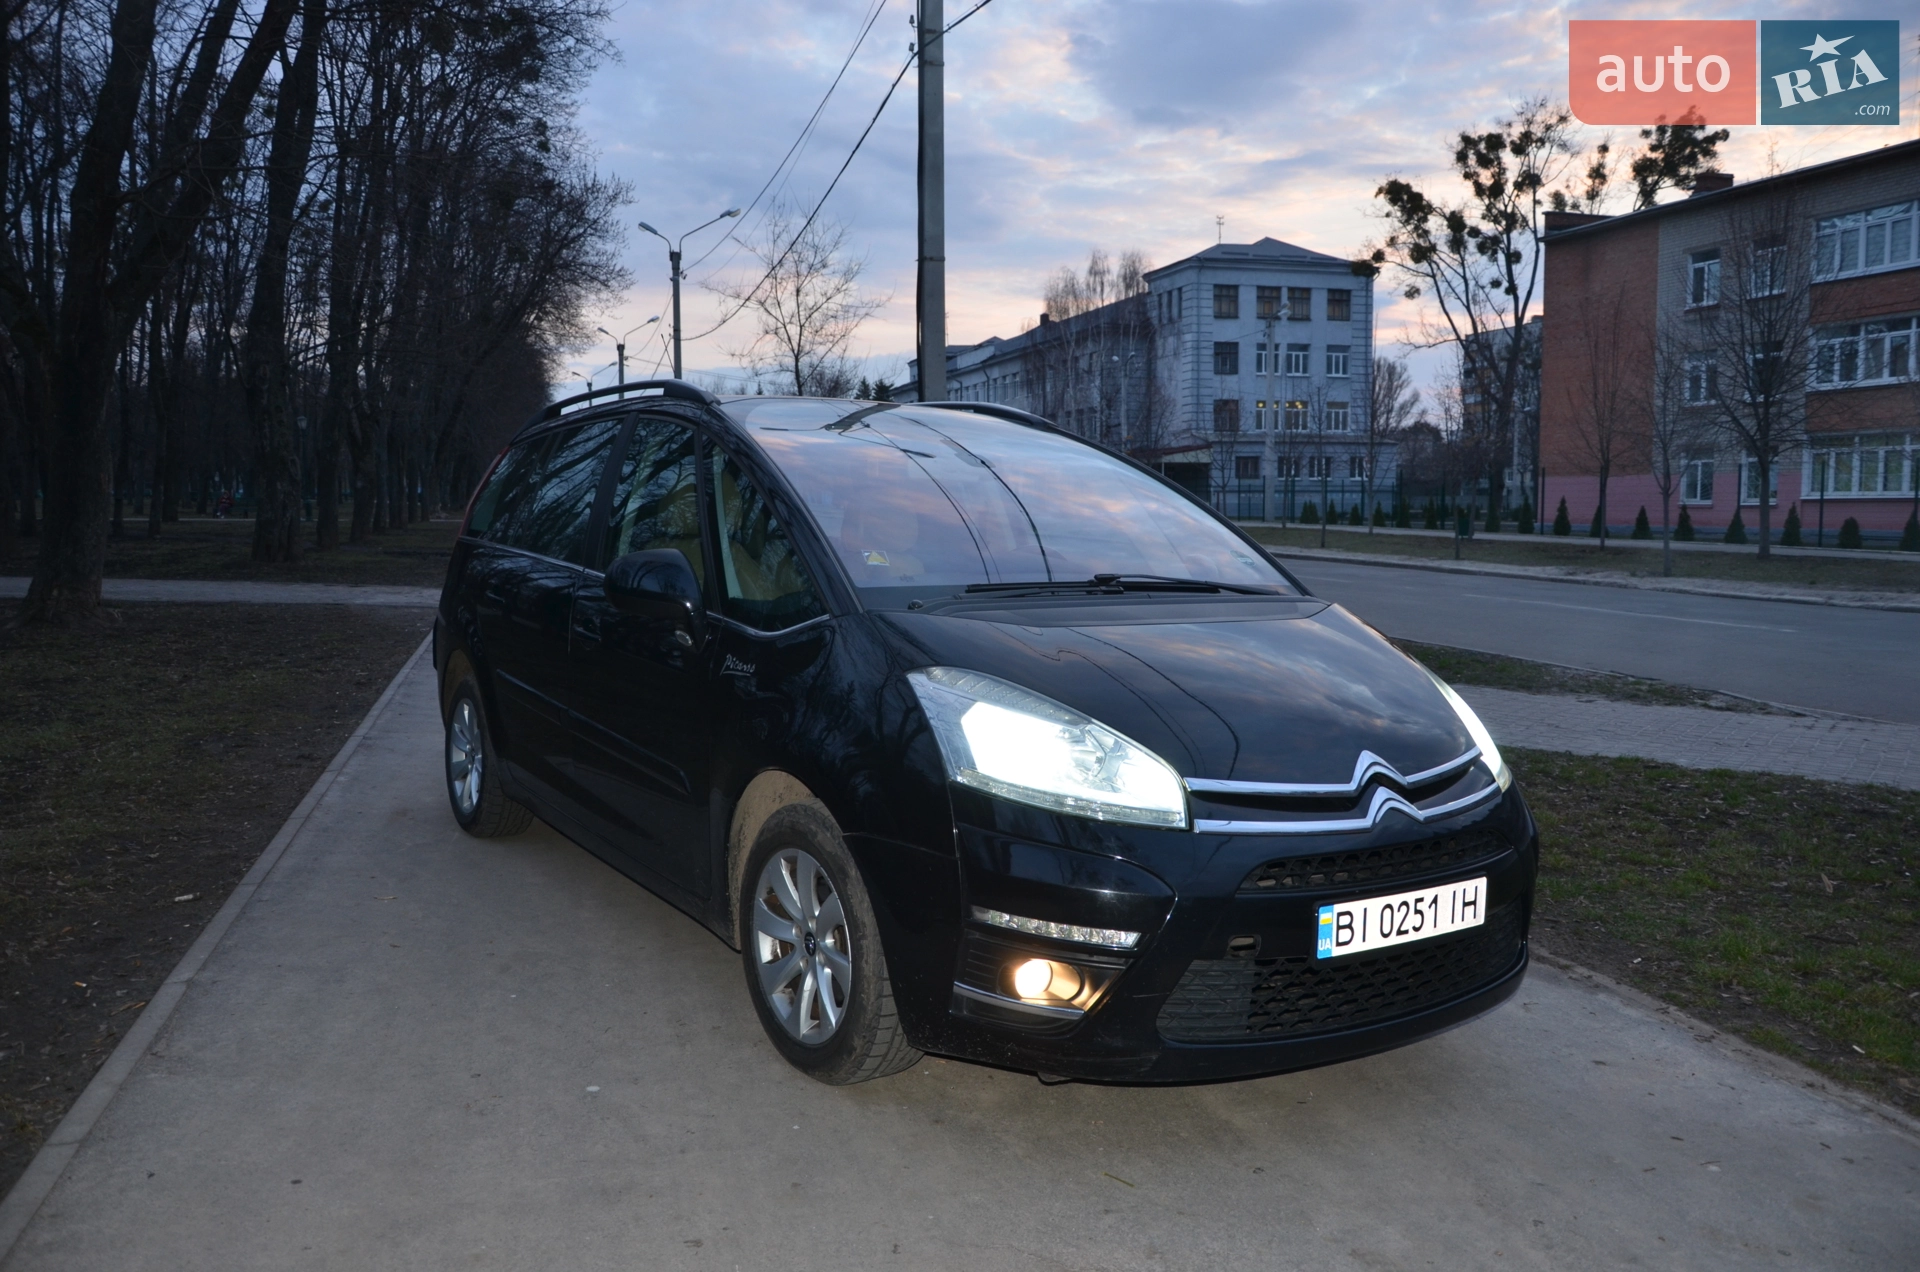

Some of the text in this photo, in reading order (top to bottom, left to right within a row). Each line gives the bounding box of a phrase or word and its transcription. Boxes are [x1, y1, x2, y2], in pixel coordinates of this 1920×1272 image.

[1335, 885, 1479, 948] BI 0251 IH
[1318, 937, 1332, 951] UA
